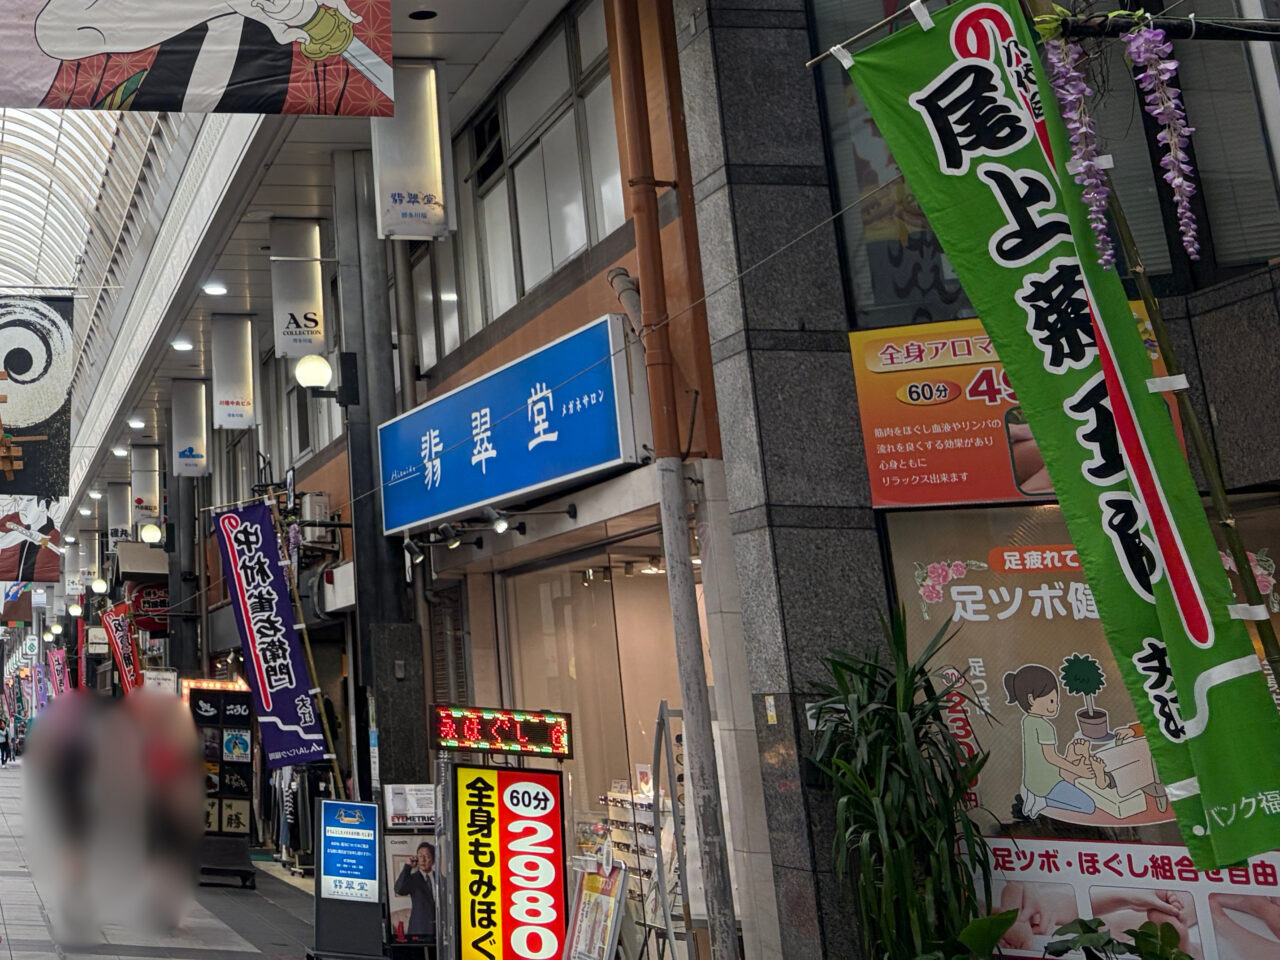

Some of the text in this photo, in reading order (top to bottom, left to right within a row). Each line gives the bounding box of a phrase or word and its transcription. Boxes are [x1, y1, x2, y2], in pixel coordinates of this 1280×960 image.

[285, 311, 319, 329] AS
[561, 389, 605, 418] メガネサロン
[908, 383, 949, 402] 60分
[420, 382, 559, 491] 翡翠堂
[876, 436, 994, 454] 流れを良くする効果があり
[879, 458, 928, 471] 心身ともに
[881, 472, 969, 487] リラックス出来ます
[950, 581, 1100, 623] 足ツボ健
[508, 790, 551, 812] 60分
[465, 776, 498, 960] 全身もみほぐ
[507, 820, 560, 960] 2980
